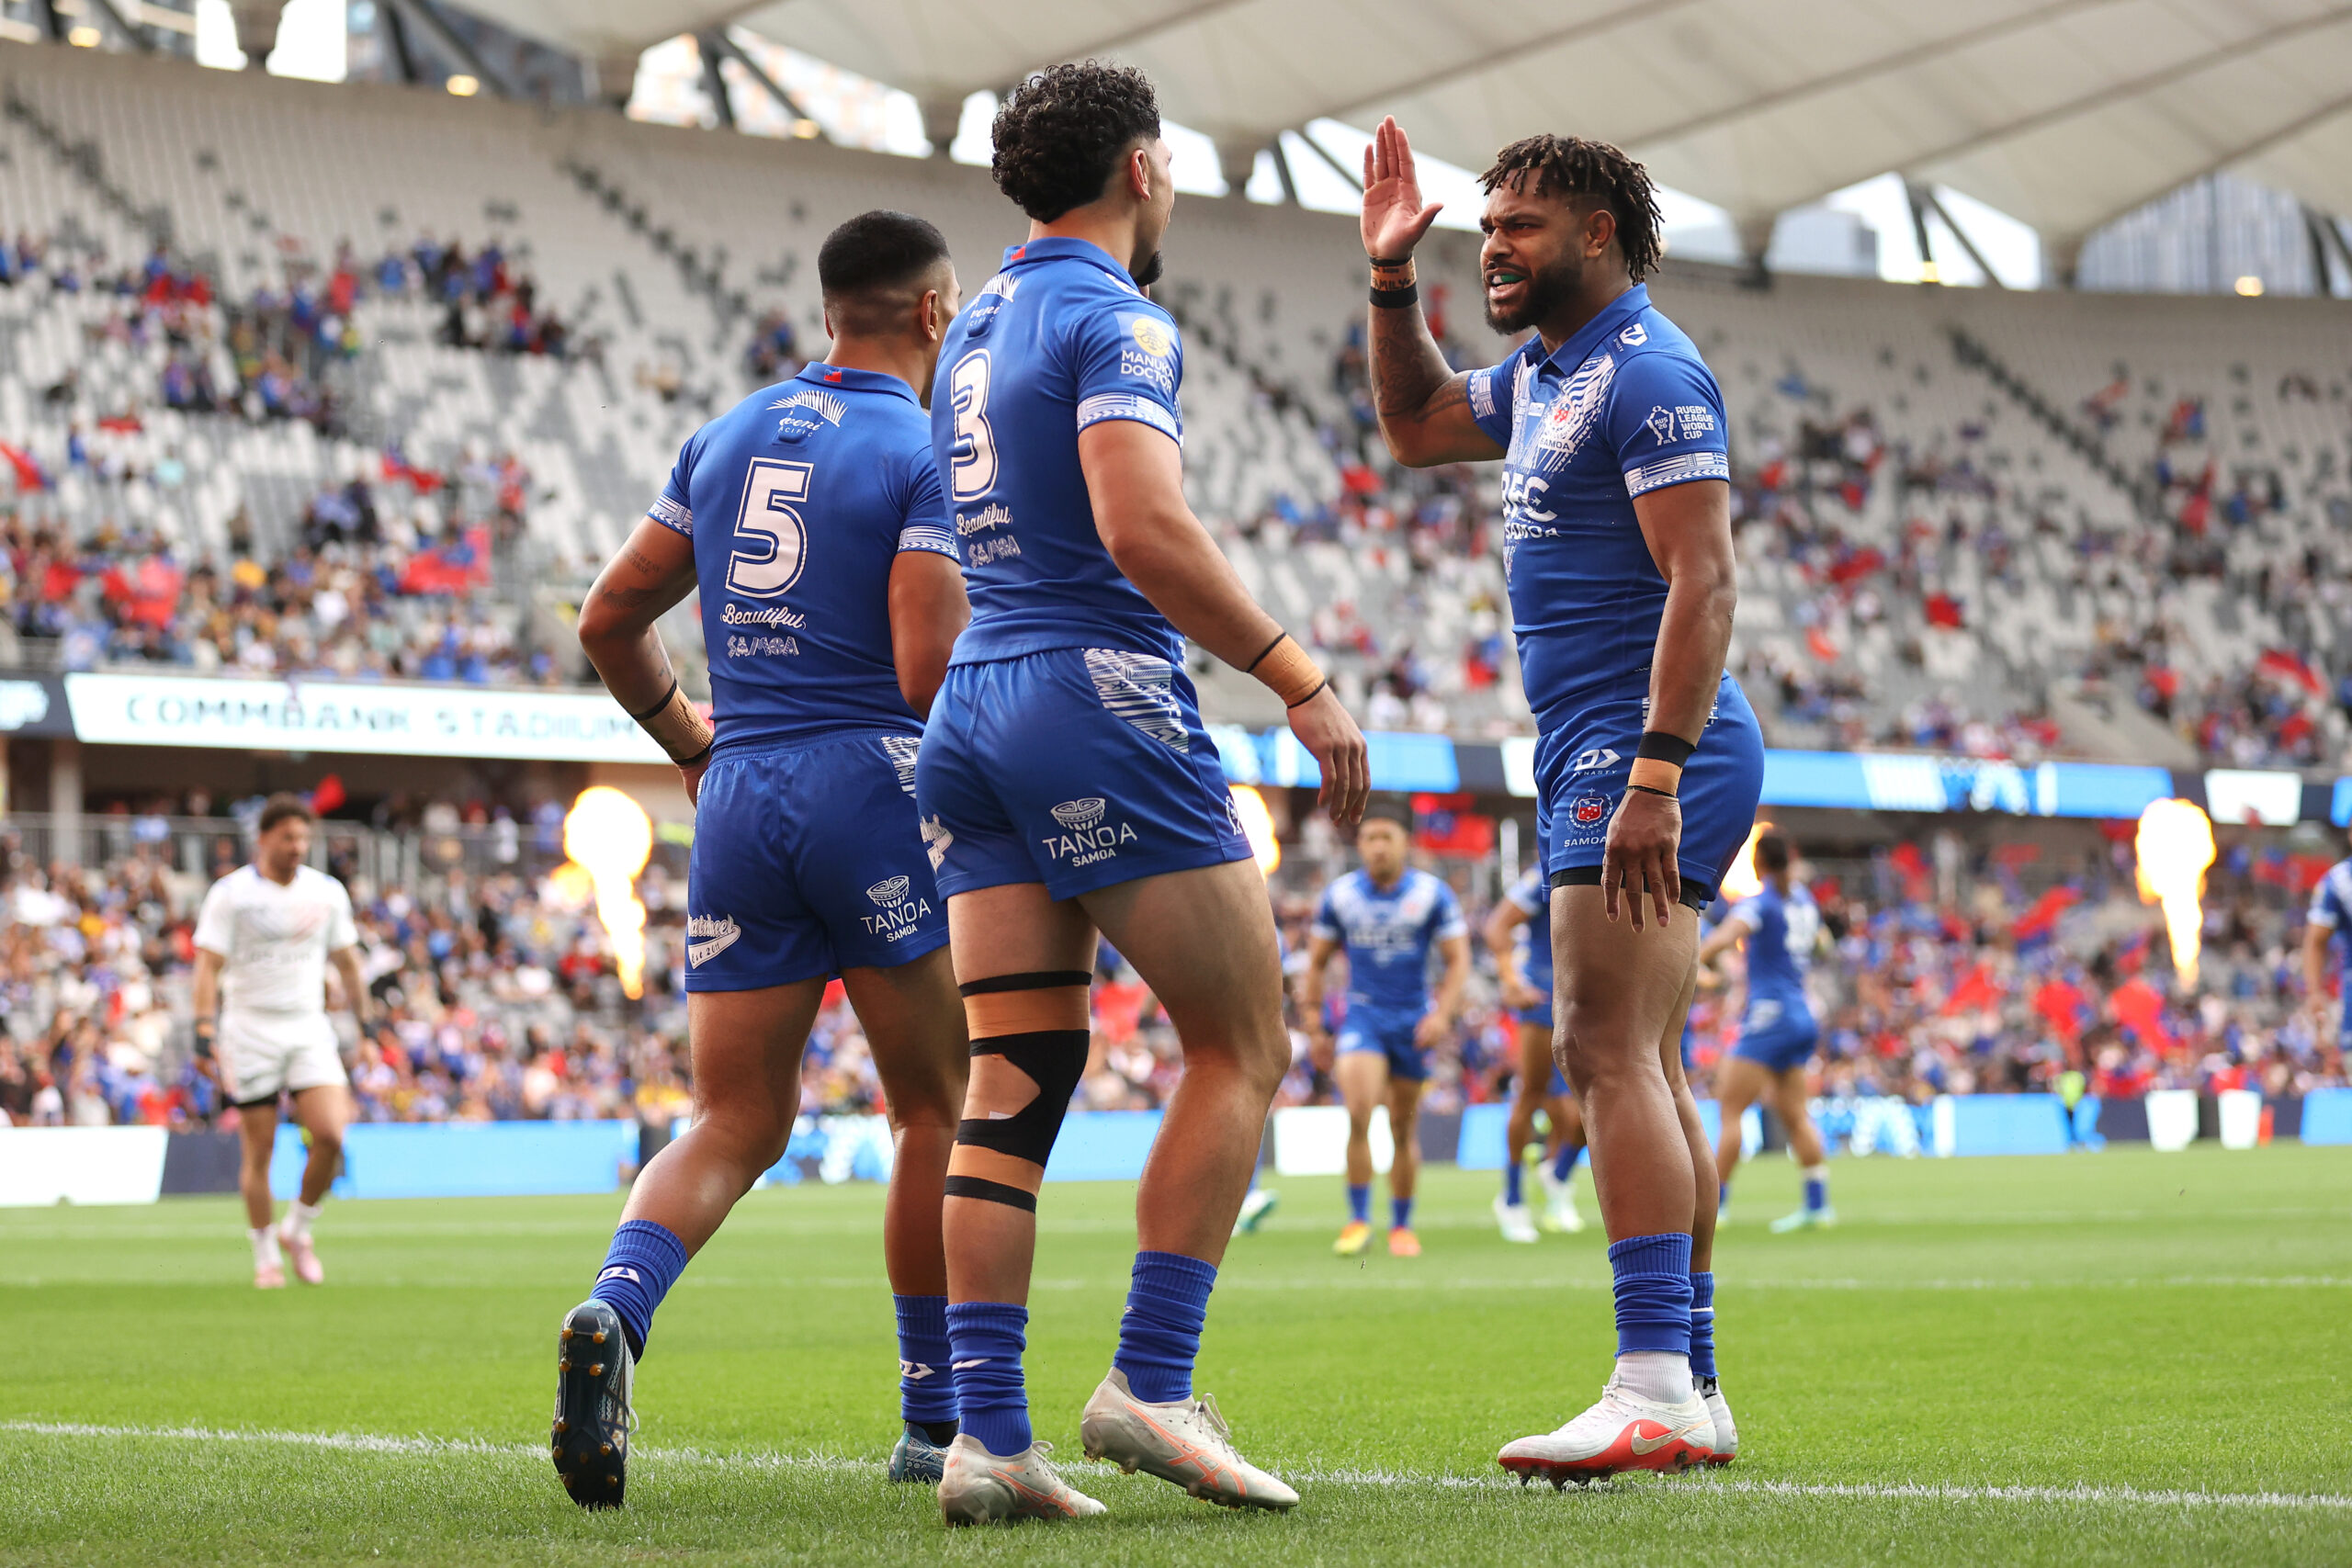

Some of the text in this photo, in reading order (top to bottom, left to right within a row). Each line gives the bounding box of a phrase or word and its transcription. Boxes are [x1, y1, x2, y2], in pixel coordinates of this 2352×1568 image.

[1120, 362, 1172, 393] DOCTOR
[1121, 349, 1175, 382] MANUKA
[1675, 405, 1707, 414] RUGBY
[1678, 414, 1714, 423] LEAGUE
[950, 347, 999, 502] 3
[1680, 423, 1714, 431] WORLD
[1683, 431, 1703, 439] CUP
[725, 457, 815, 598] 5
[956, 502, 1012, 536] Beautiful
[721, 603, 805, 630] Beautiful
[727, 634, 800, 659] SAMOA
[126, 694, 639, 739] COMMBANK STADIUM
[1042, 822, 1138, 860] TANOA
[1564, 836, 1607, 848] SAMOA
[1071, 847, 1117, 867] SAMOA
[860, 897, 932, 935] TANOA
[886, 923, 918, 942] SAMOA
